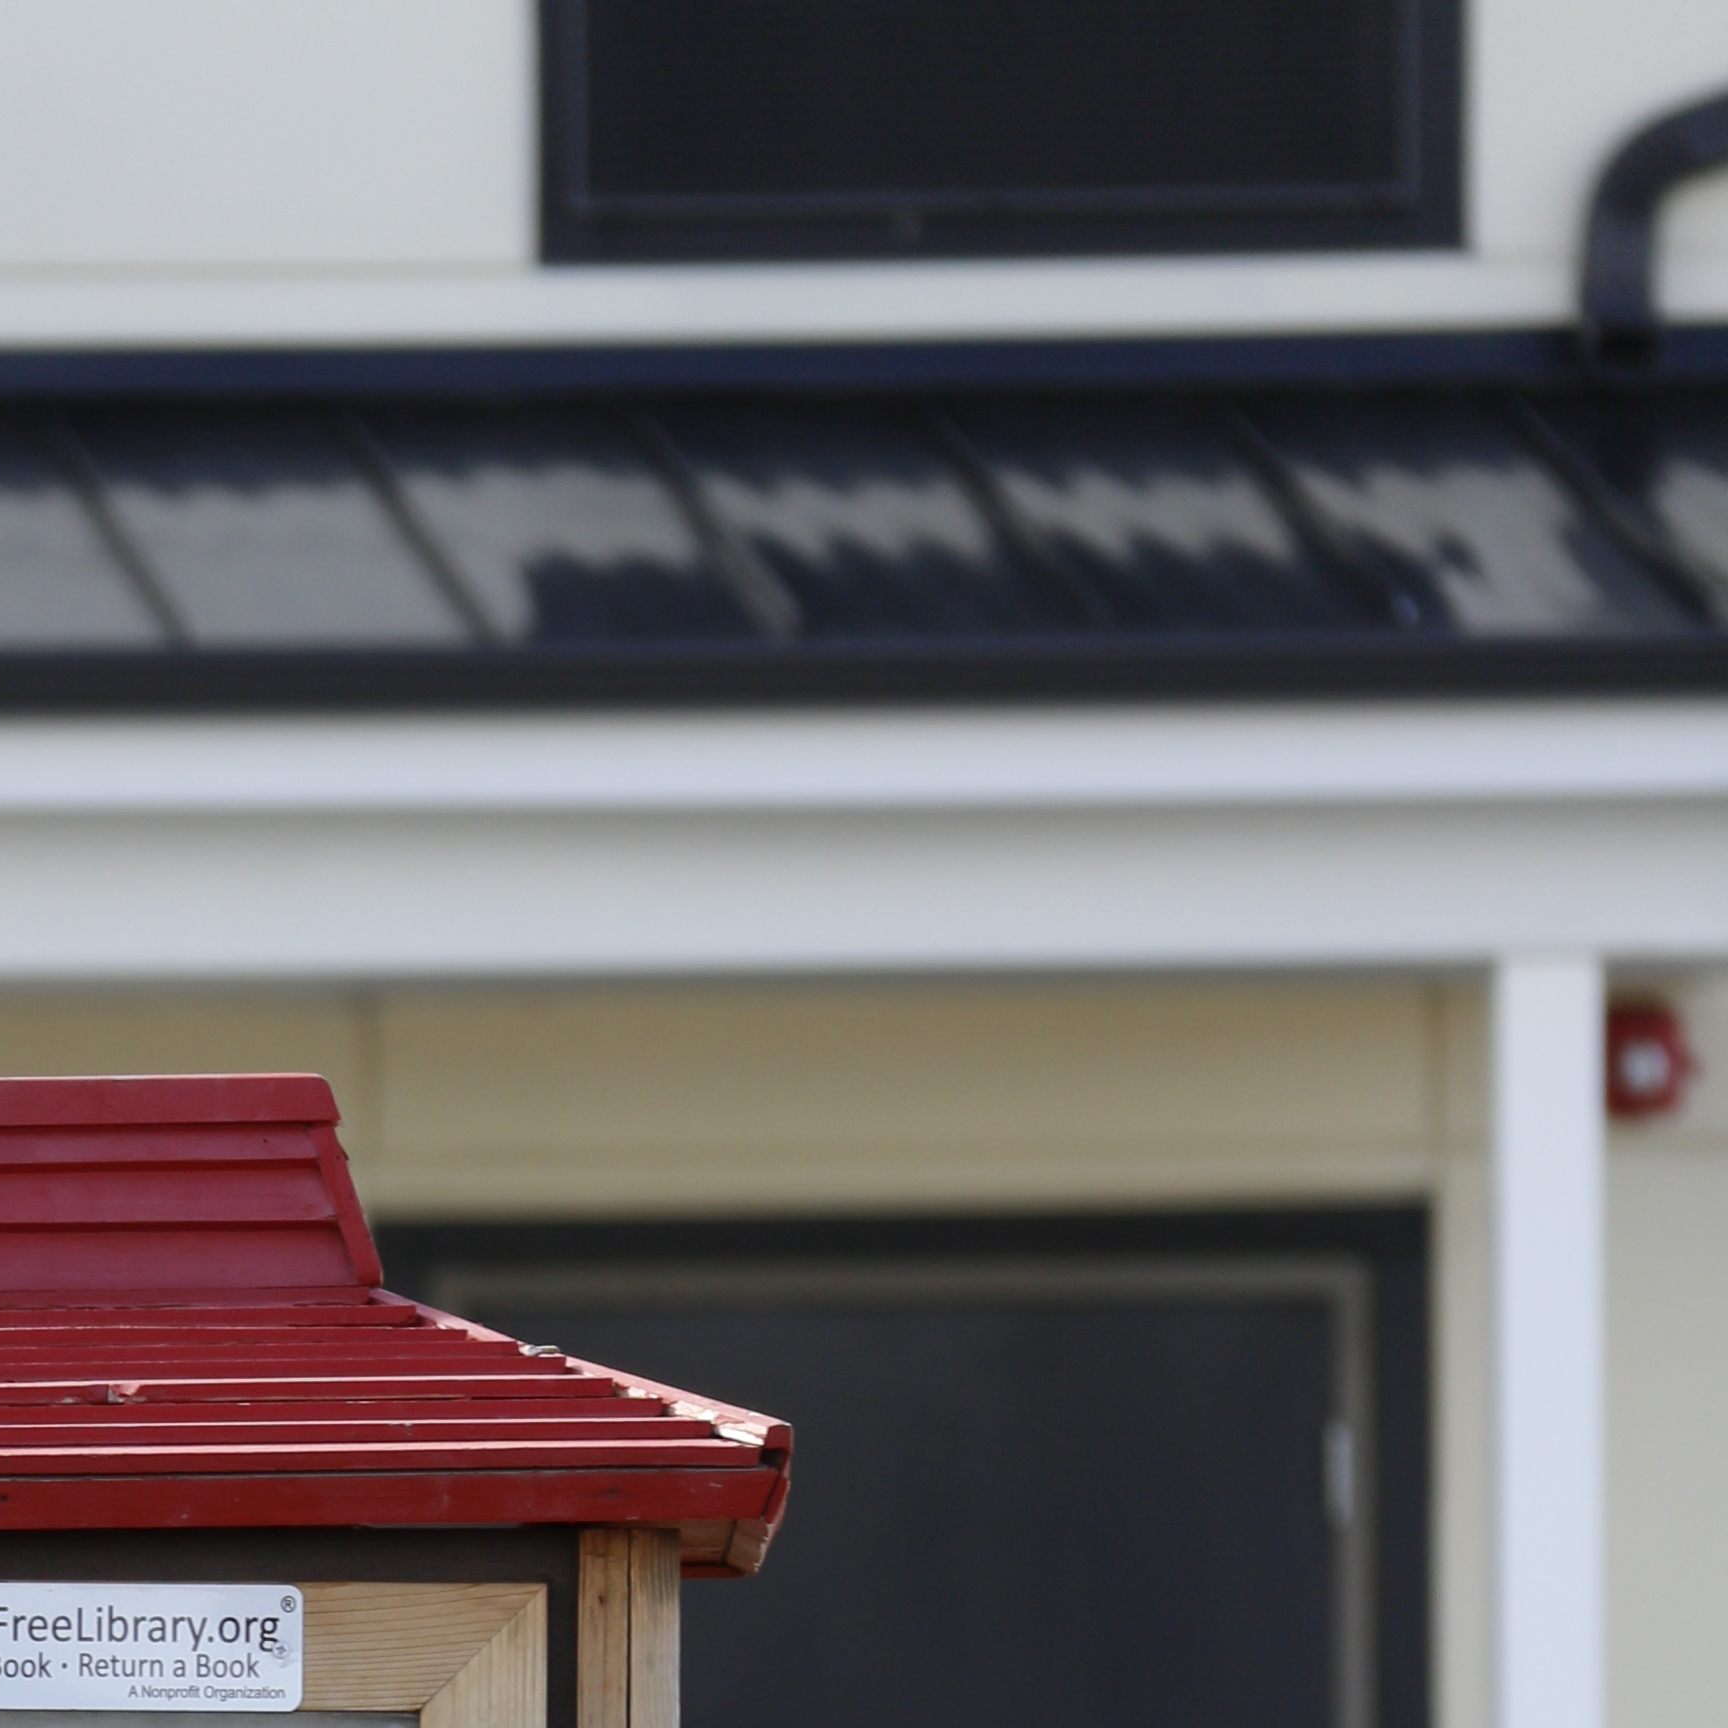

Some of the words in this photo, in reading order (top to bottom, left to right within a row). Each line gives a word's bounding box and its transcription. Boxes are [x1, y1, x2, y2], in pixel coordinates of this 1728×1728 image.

[78, 1653, 164, 1678] Return
[173, 1659, 186, 1678] a
[196, 1653, 260, 1678] Book
[128, 1685, 138, 1698] A
[141, 1685, 200, 1701] Nonprofit
[203, 1685, 286, 1702] Organization
